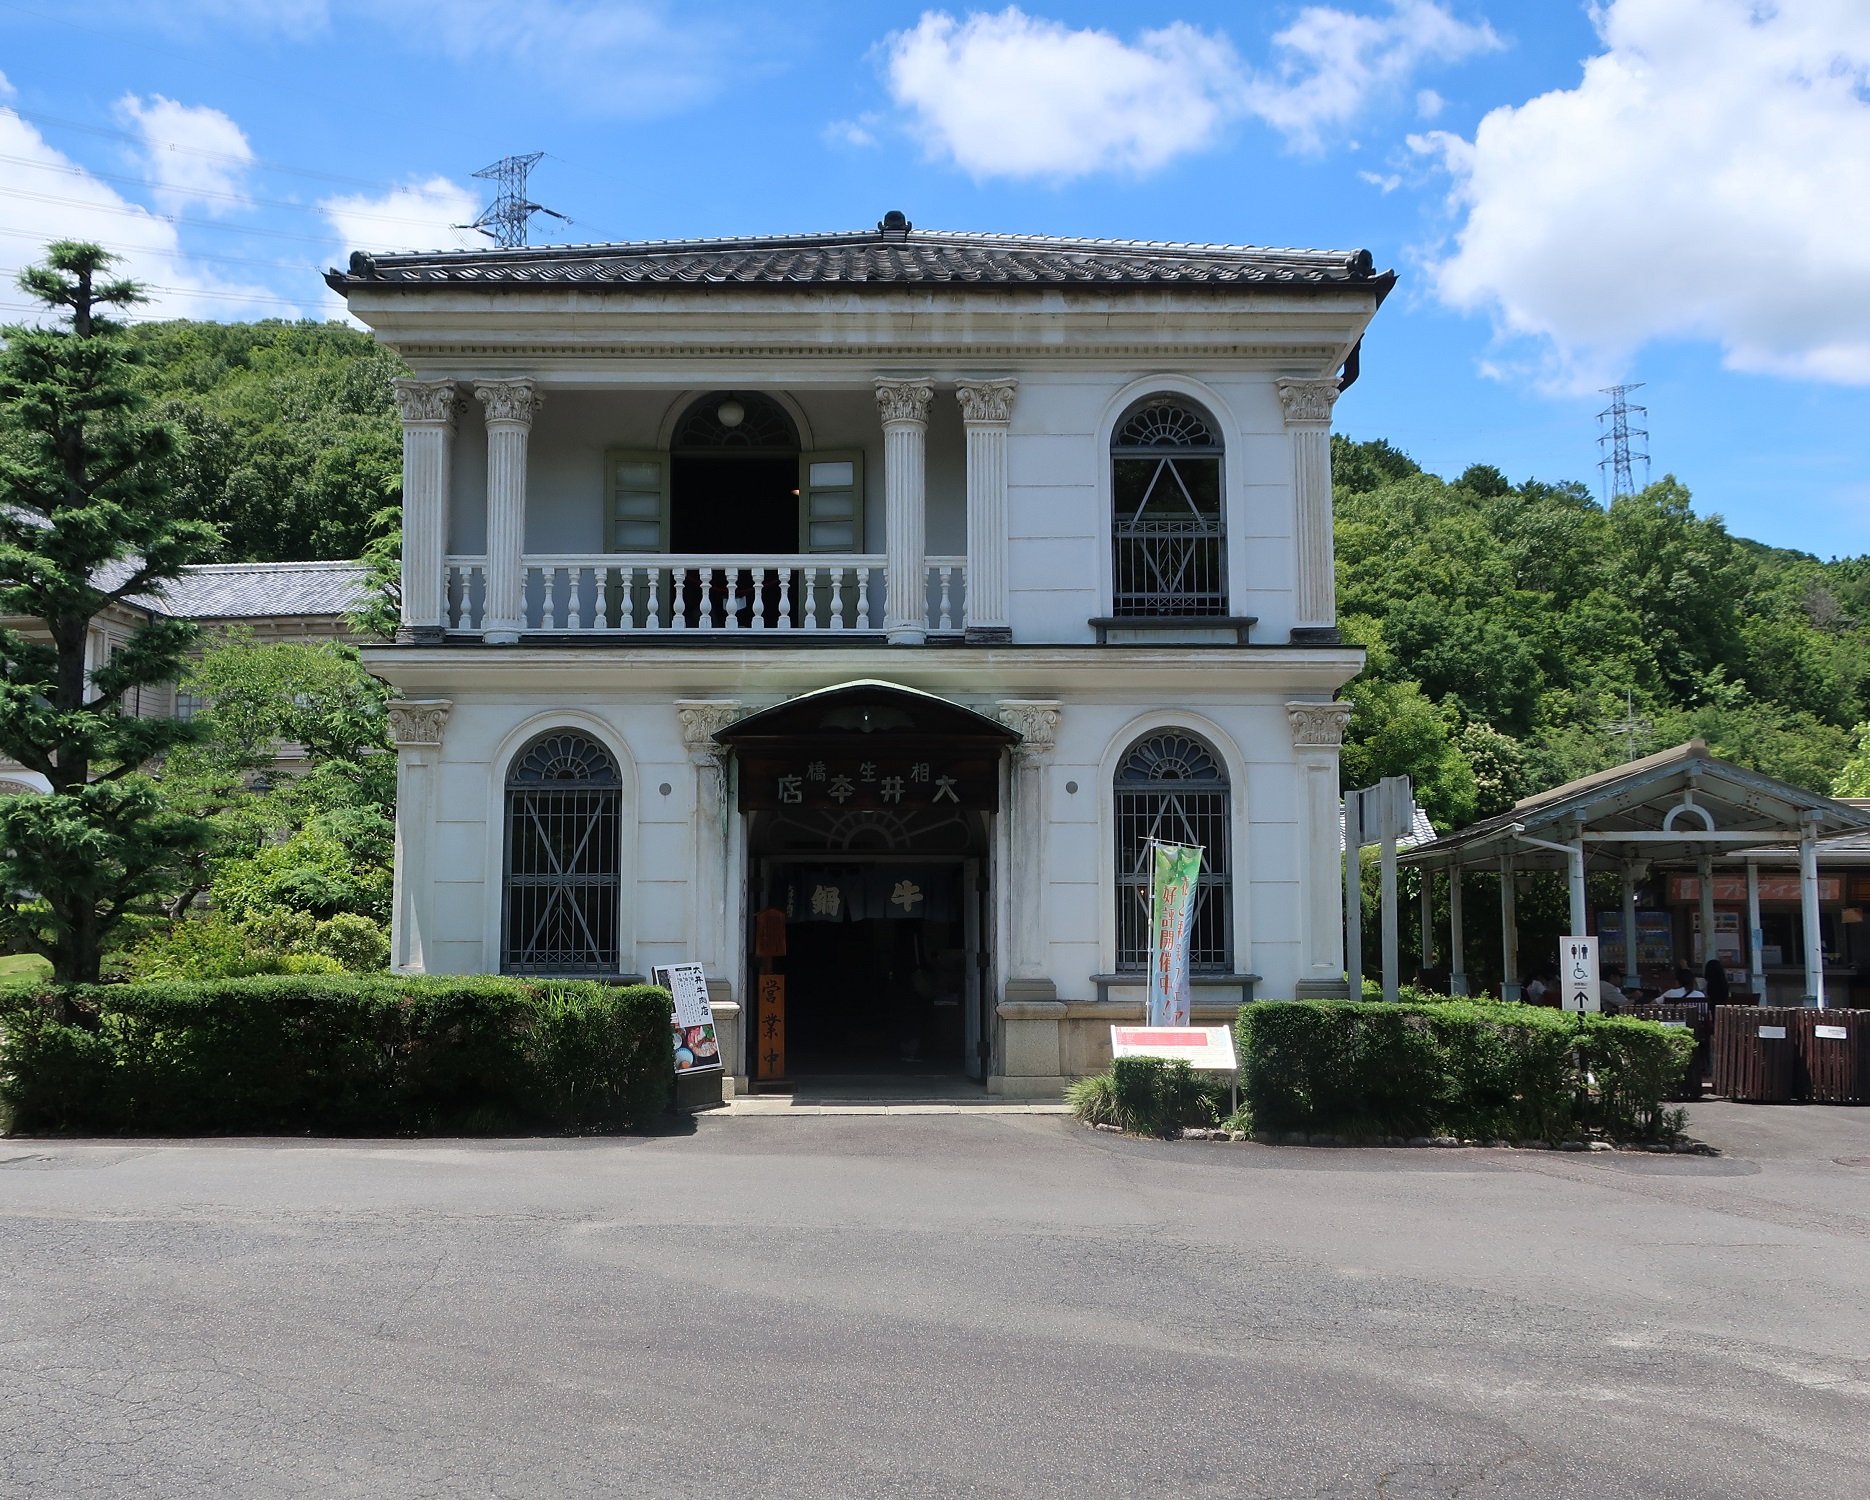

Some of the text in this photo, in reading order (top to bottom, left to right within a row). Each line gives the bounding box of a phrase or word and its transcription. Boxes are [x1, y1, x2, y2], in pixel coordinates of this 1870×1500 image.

[806, 761, 930, 783] 相生橋
[810, 879, 924, 917] 牛鍋
[1158, 885, 1178, 1017] 好評開催中！
[692, 966, 709, 1016] 大井牛肉店
[761, 979, 781, 1074] 営業中
